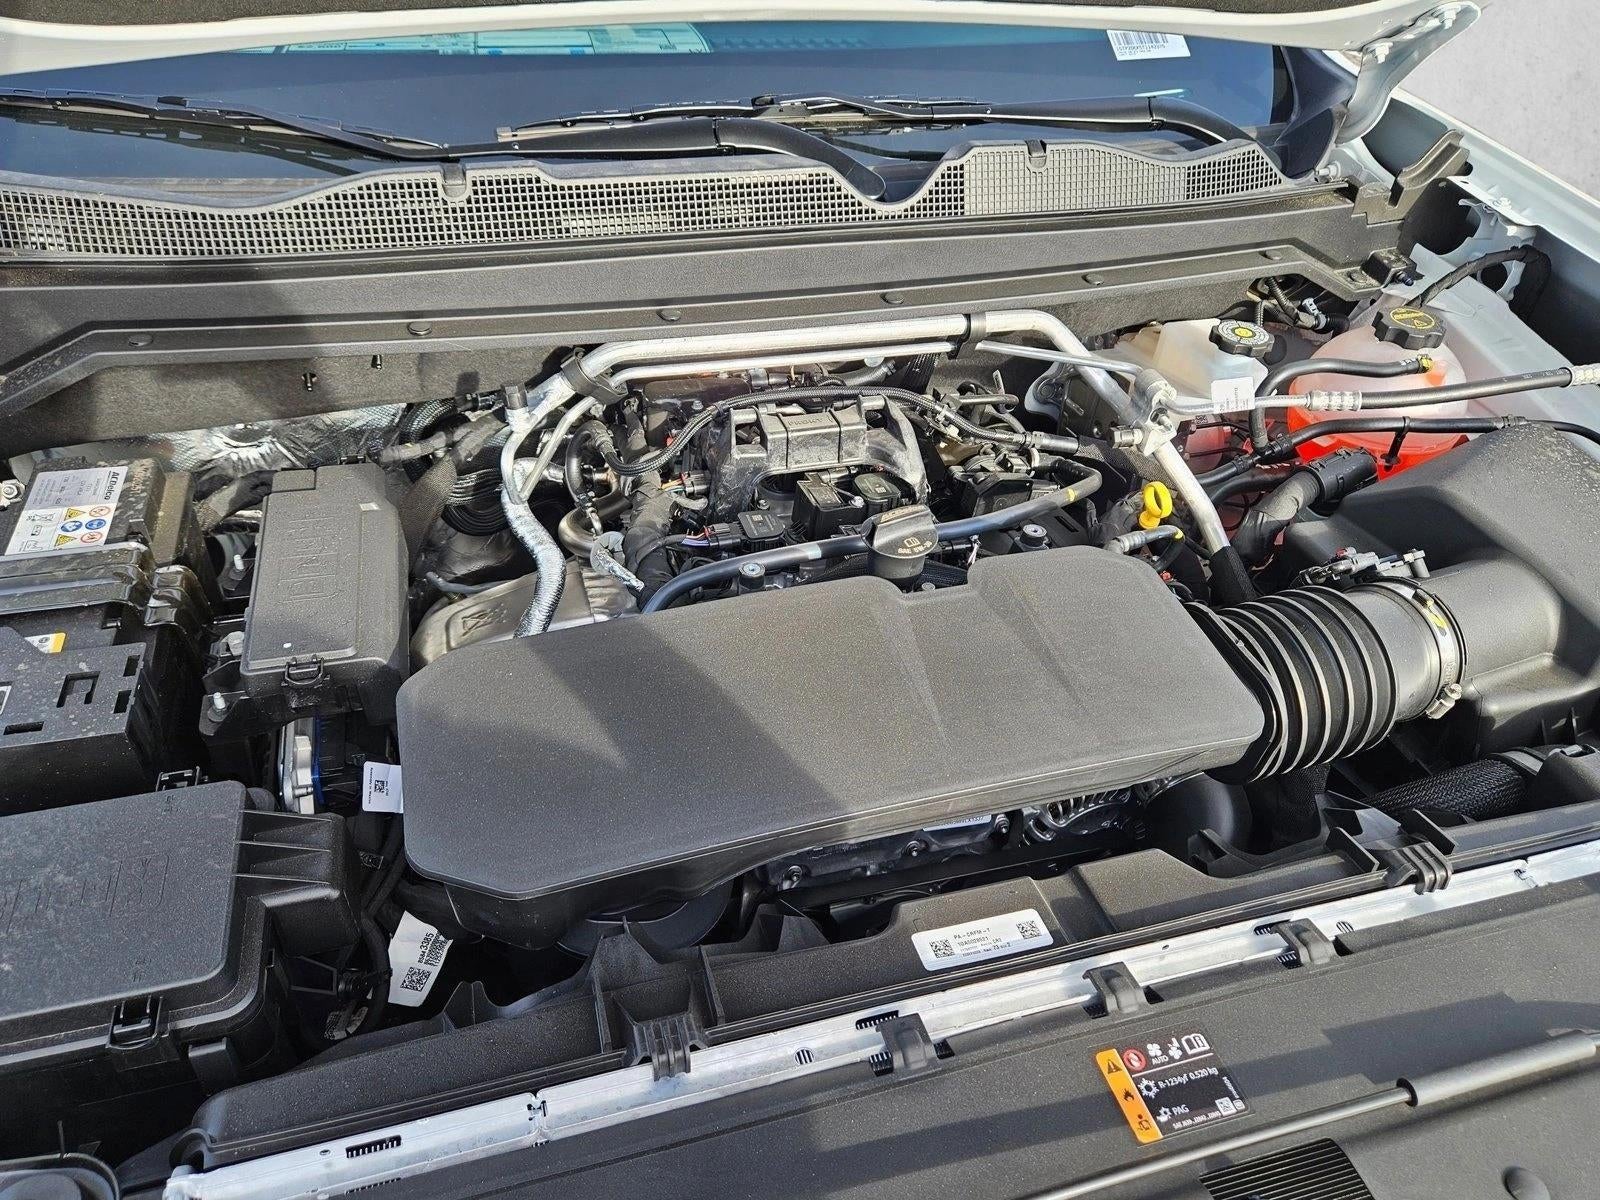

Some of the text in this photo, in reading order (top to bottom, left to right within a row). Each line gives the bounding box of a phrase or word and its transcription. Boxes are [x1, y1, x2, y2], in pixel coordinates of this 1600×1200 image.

[104, 471, 120, 501] ACDelco
[1151, 1055, 1169, 1066] AUTO
[1158, 1066, 1219, 1089] R-1234yf 0.520 kg
[1171, 1104, 1190, 1116] PAG
